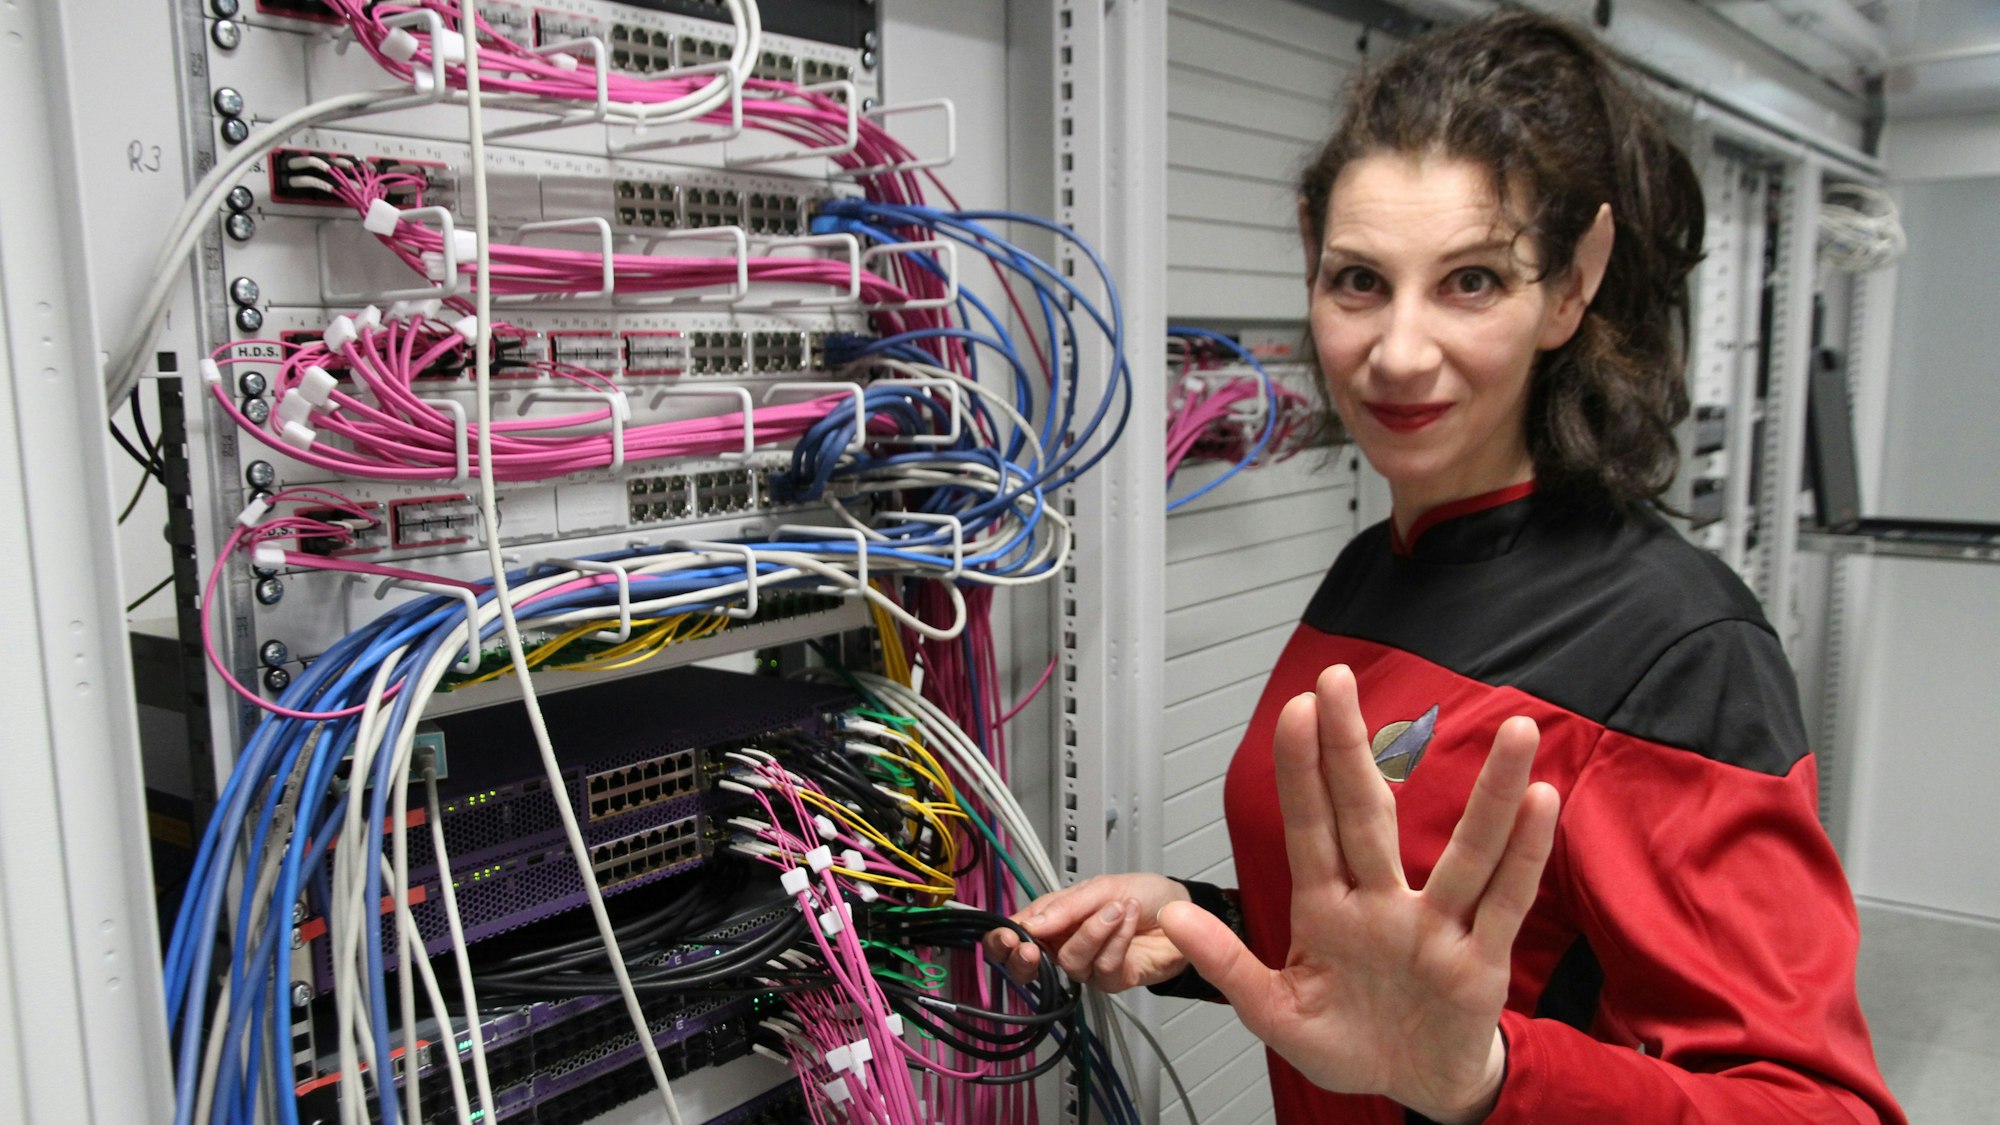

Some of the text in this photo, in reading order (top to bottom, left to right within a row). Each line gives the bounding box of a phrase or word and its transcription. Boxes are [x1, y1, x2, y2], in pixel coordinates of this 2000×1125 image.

[127, 139, 161, 173] R3
[238, 346, 279, 357] H.D.S.
[256, 527, 293, 536] .D.S.
